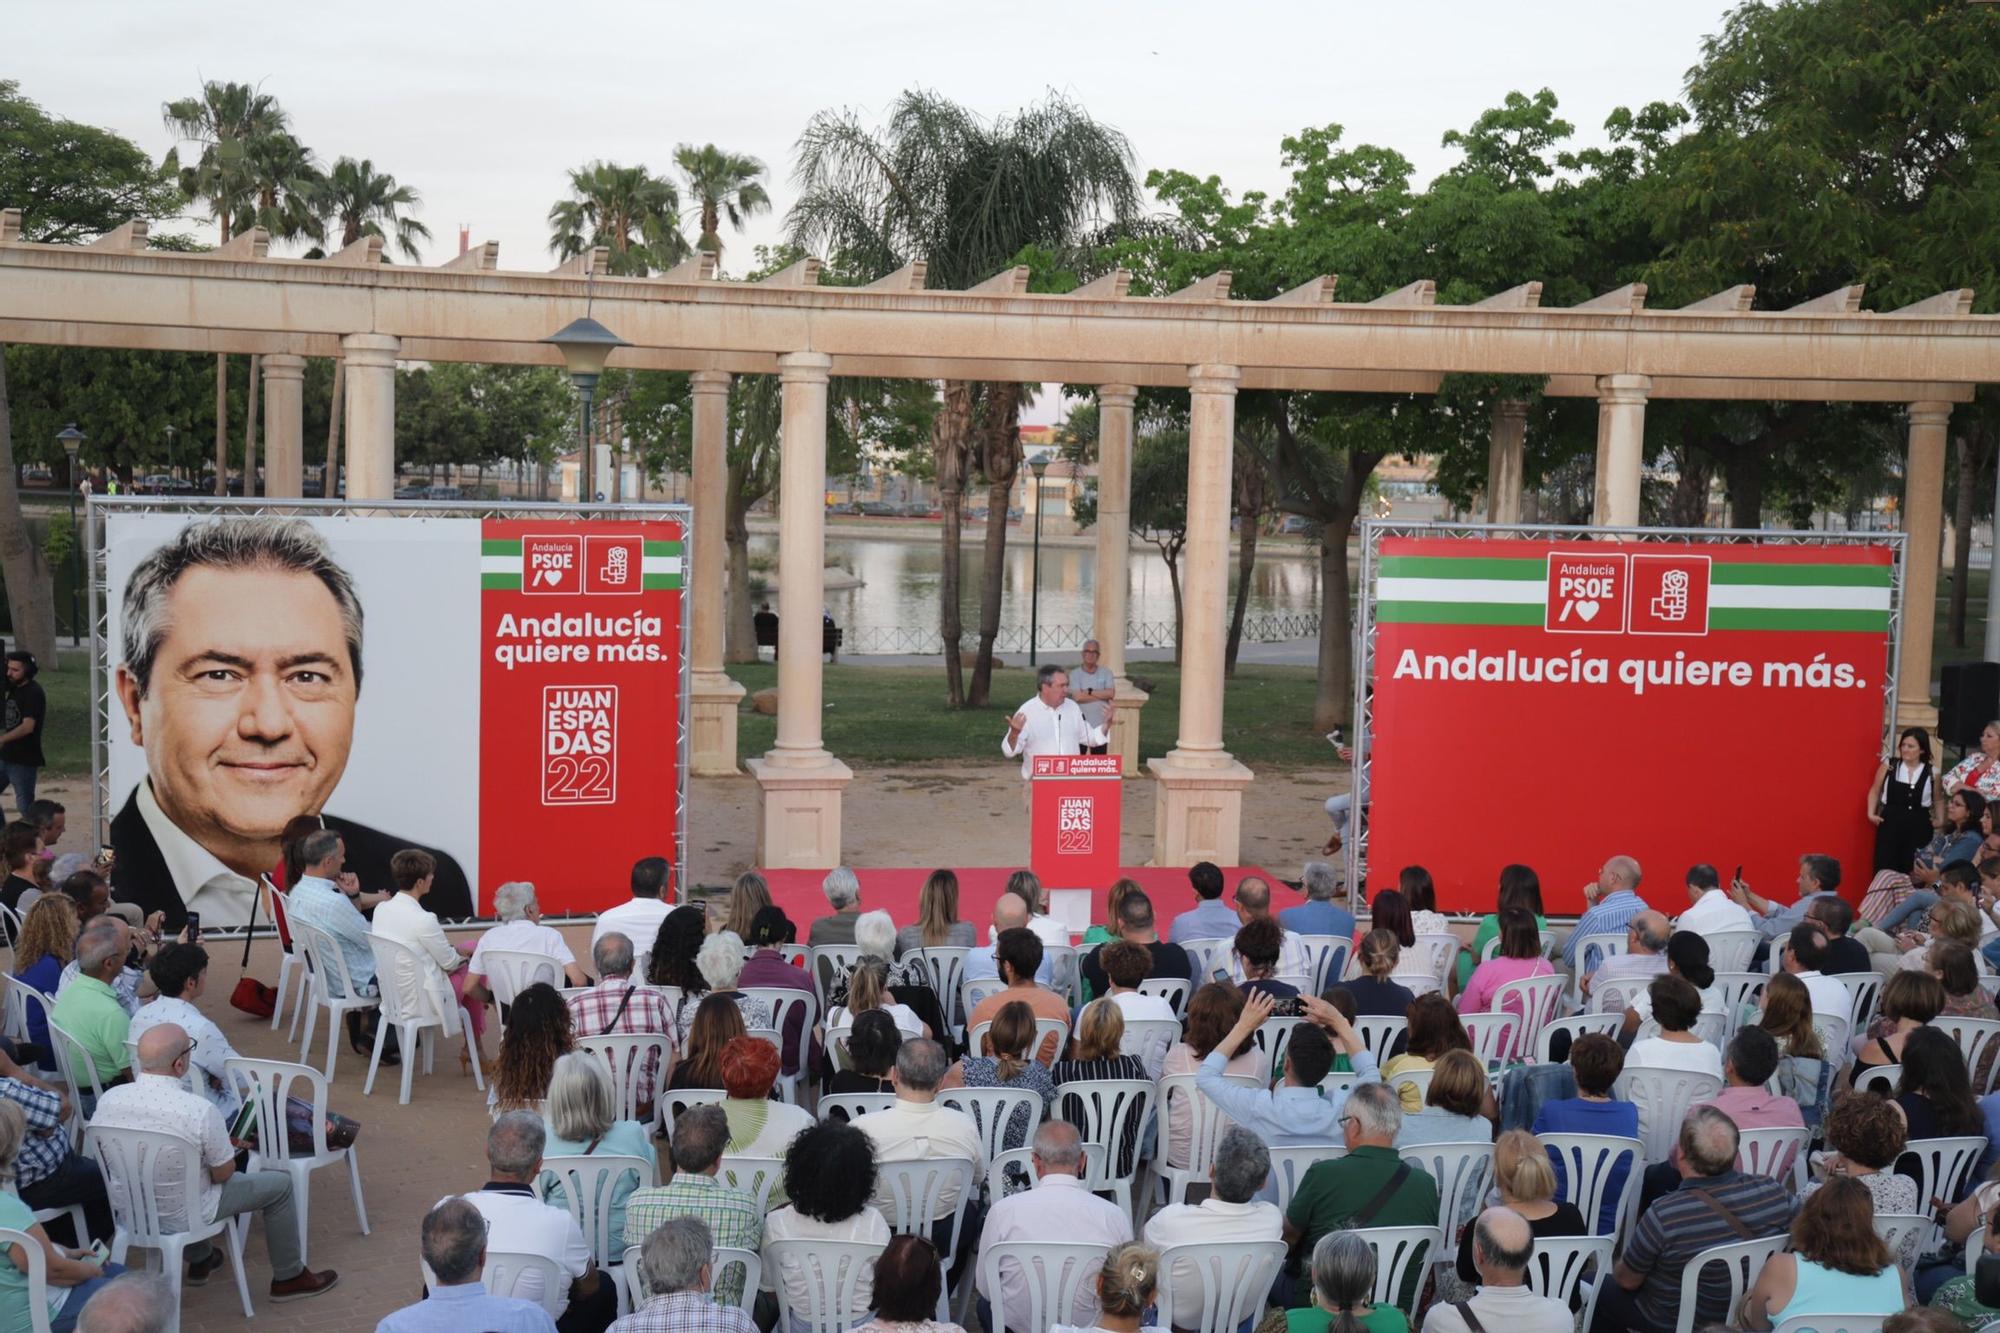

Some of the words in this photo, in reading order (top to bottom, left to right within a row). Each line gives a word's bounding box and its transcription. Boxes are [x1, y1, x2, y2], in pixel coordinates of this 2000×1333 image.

[532, 553, 573, 569] PSOE
[1560, 563, 1615, 575] Andalucía
[1560, 577, 1614, 599] PSOE
[496, 610, 661, 637] Andalucía
[495, 638, 590, 670] quiere
[597, 637, 668, 662] más.
[1393, 648, 1608, 683] Andalucía
[1619, 650, 1752, 694] quiere
[1762, 653, 1866, 689] más.
[549, 690, 611, 709] JUAN
[548, 709, 611, 730] ESPA
[548, 730, 611, 755] DAS
[547, 756, 610, 800] 22
[1070, 765, 1097, 774] quiere
[1061, 799, 1091, 808] JUAN
[1061, 808, 1091, 818] ESPA
[1060, 818, 1091, 830] DAS
[1060, 830, 1091, 852] 22
